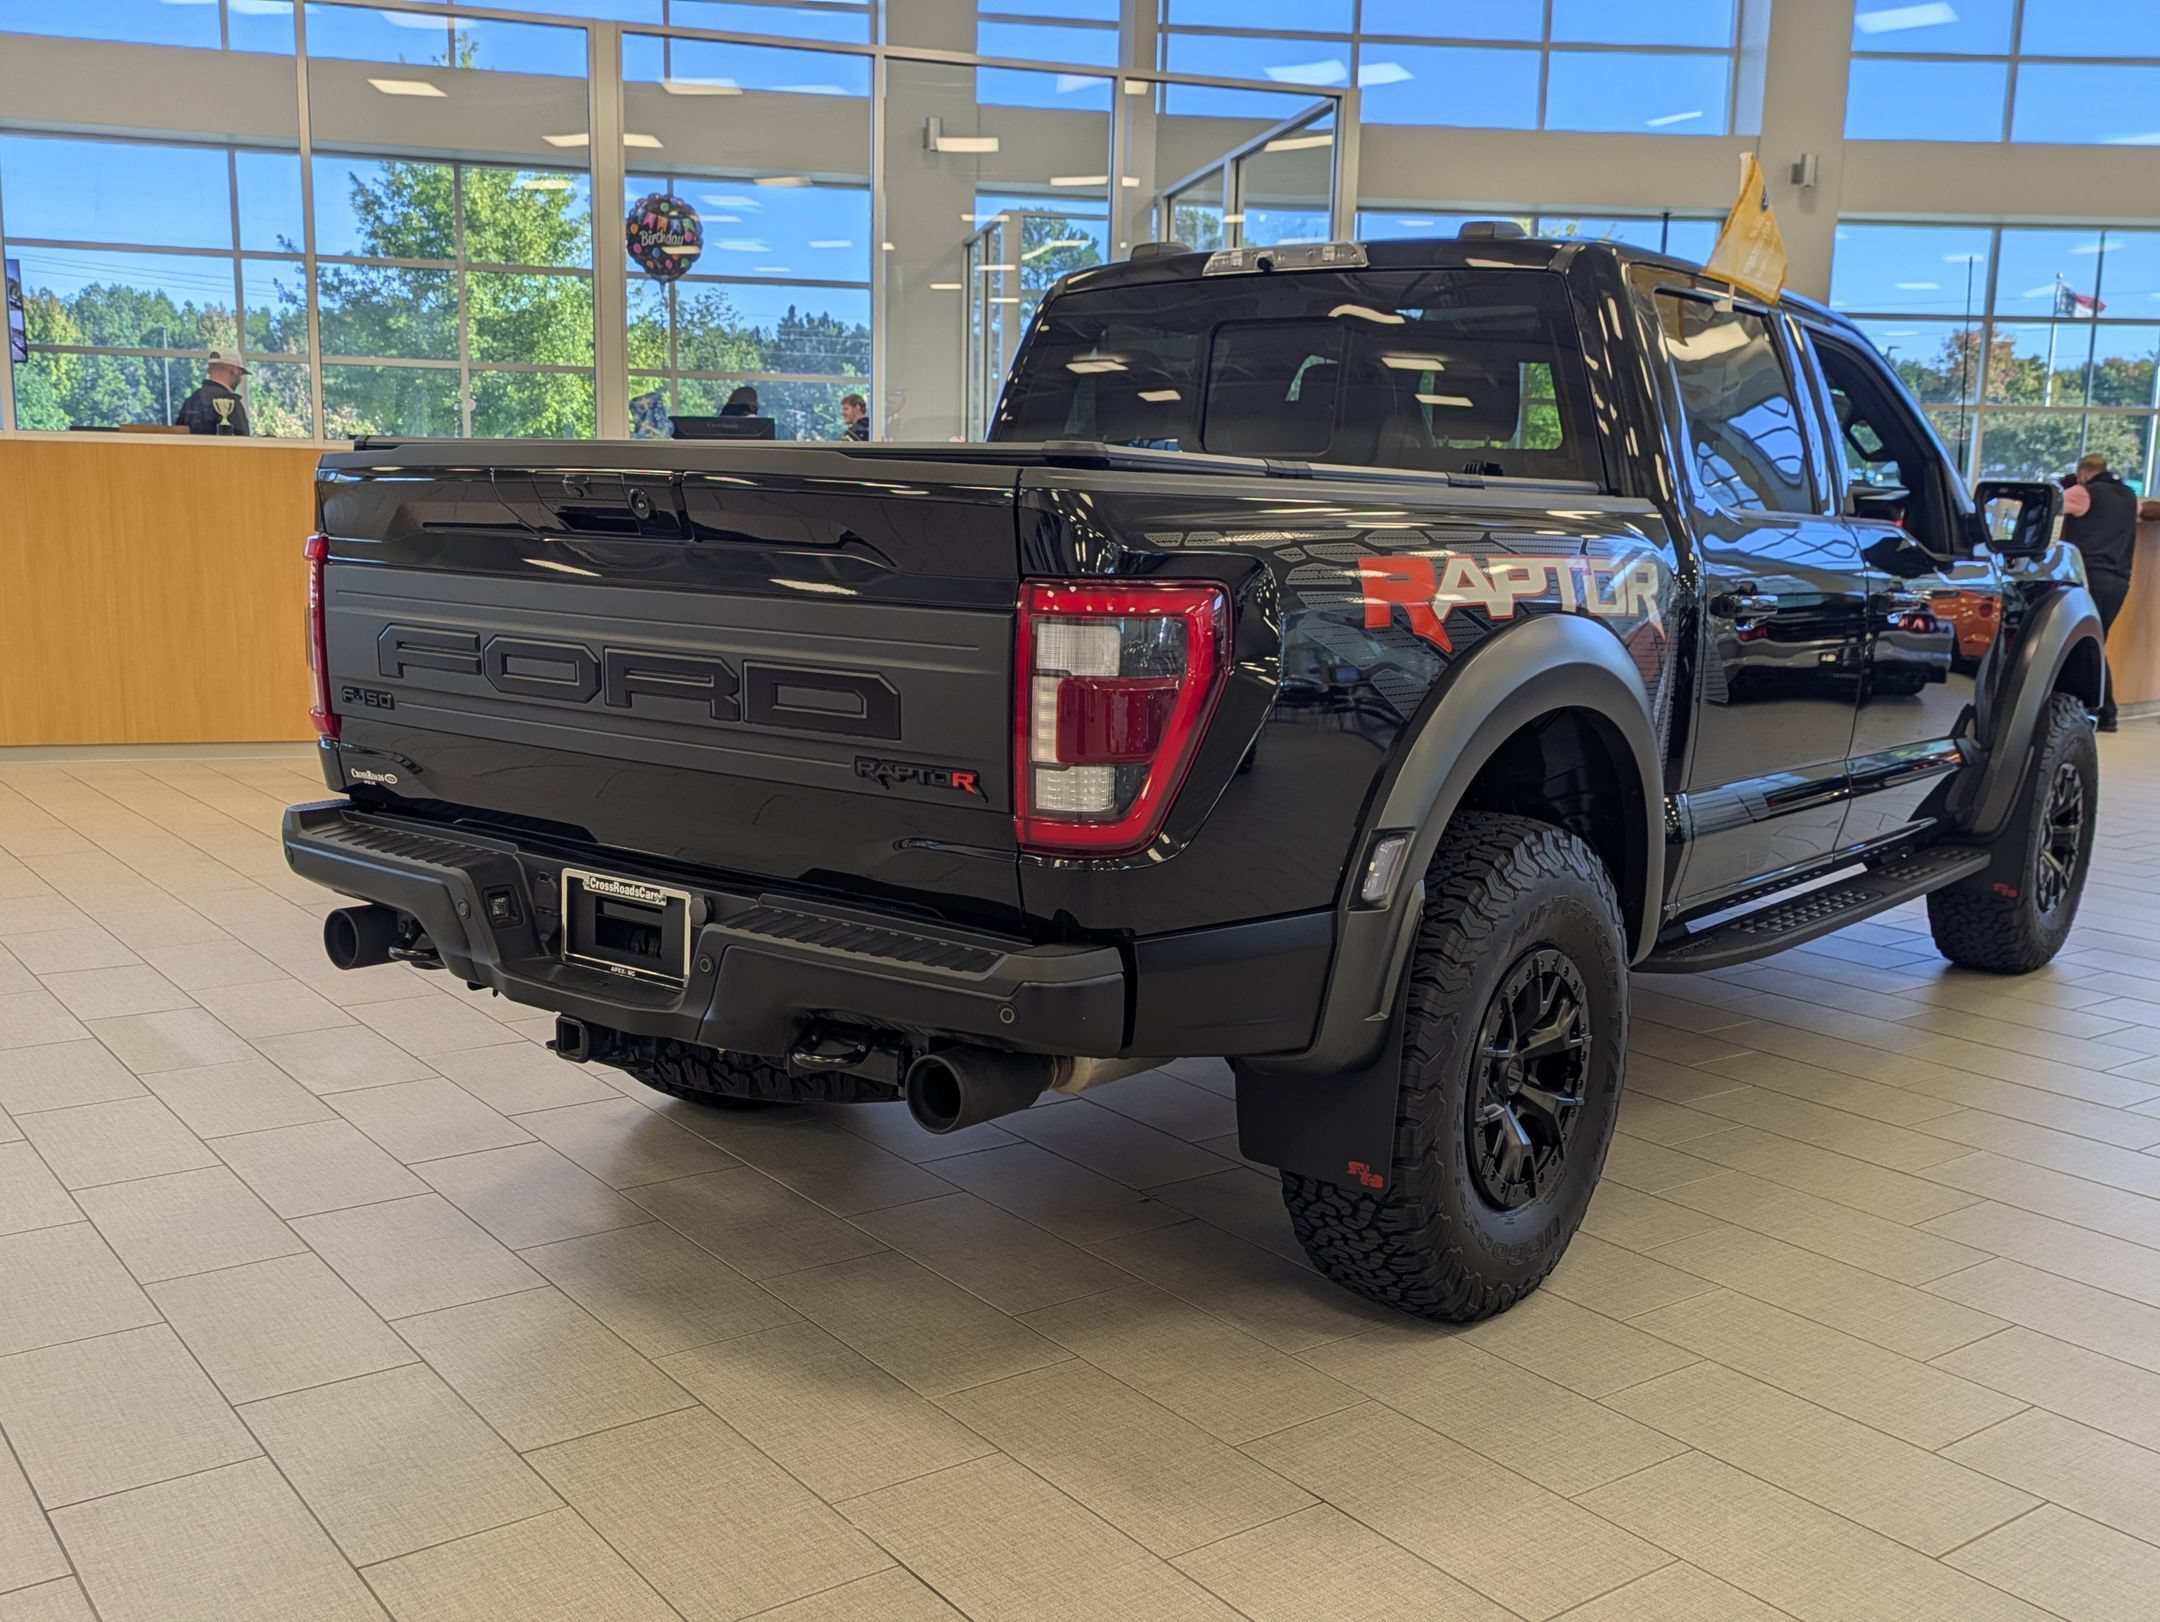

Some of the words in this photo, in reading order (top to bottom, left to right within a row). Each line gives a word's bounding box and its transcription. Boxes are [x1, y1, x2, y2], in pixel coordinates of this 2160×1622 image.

[640, 230, 685, 247] Birthday
[1358, 555, 1666, 652] RAPTOR
[342, 686, 395, 710] F-150
[377, 622, 902, 742] FORD
[855, 756, 988, 802] RAPTOR
